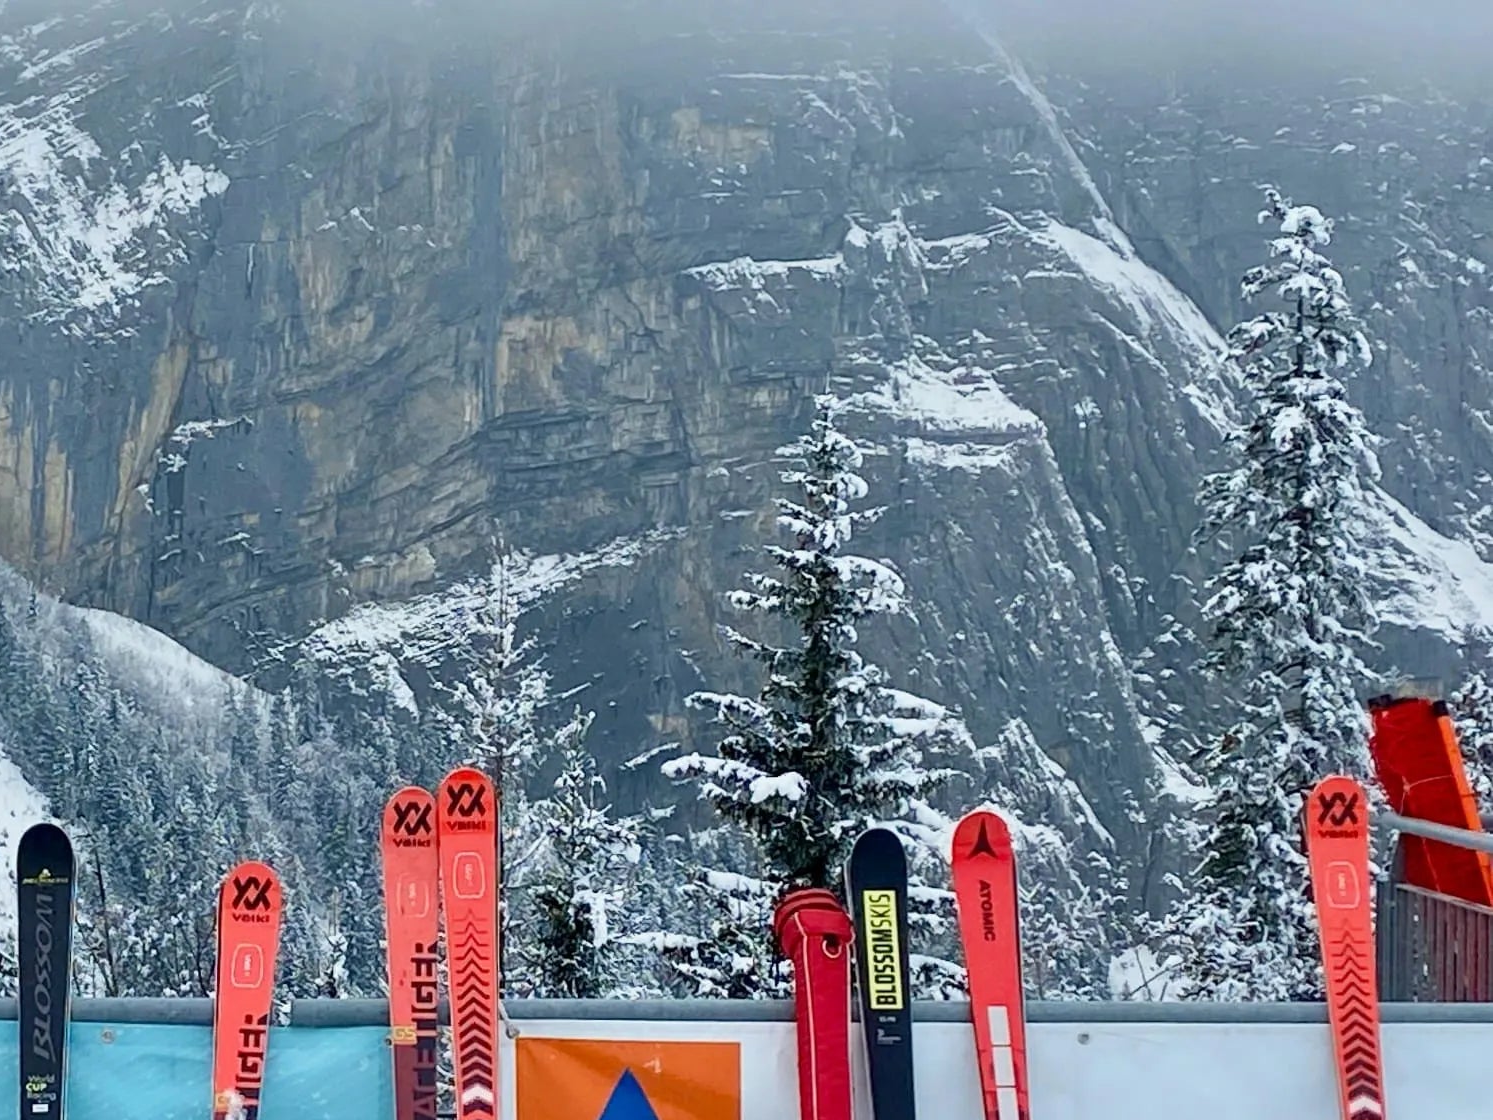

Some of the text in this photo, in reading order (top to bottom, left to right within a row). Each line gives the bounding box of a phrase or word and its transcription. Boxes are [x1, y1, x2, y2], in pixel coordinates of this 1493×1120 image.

[979, 880, 996, 942] ATOMIC
[33, 892, 56, 1063] BLOSSOM
[26, 1083, 48, 1092] CUP
